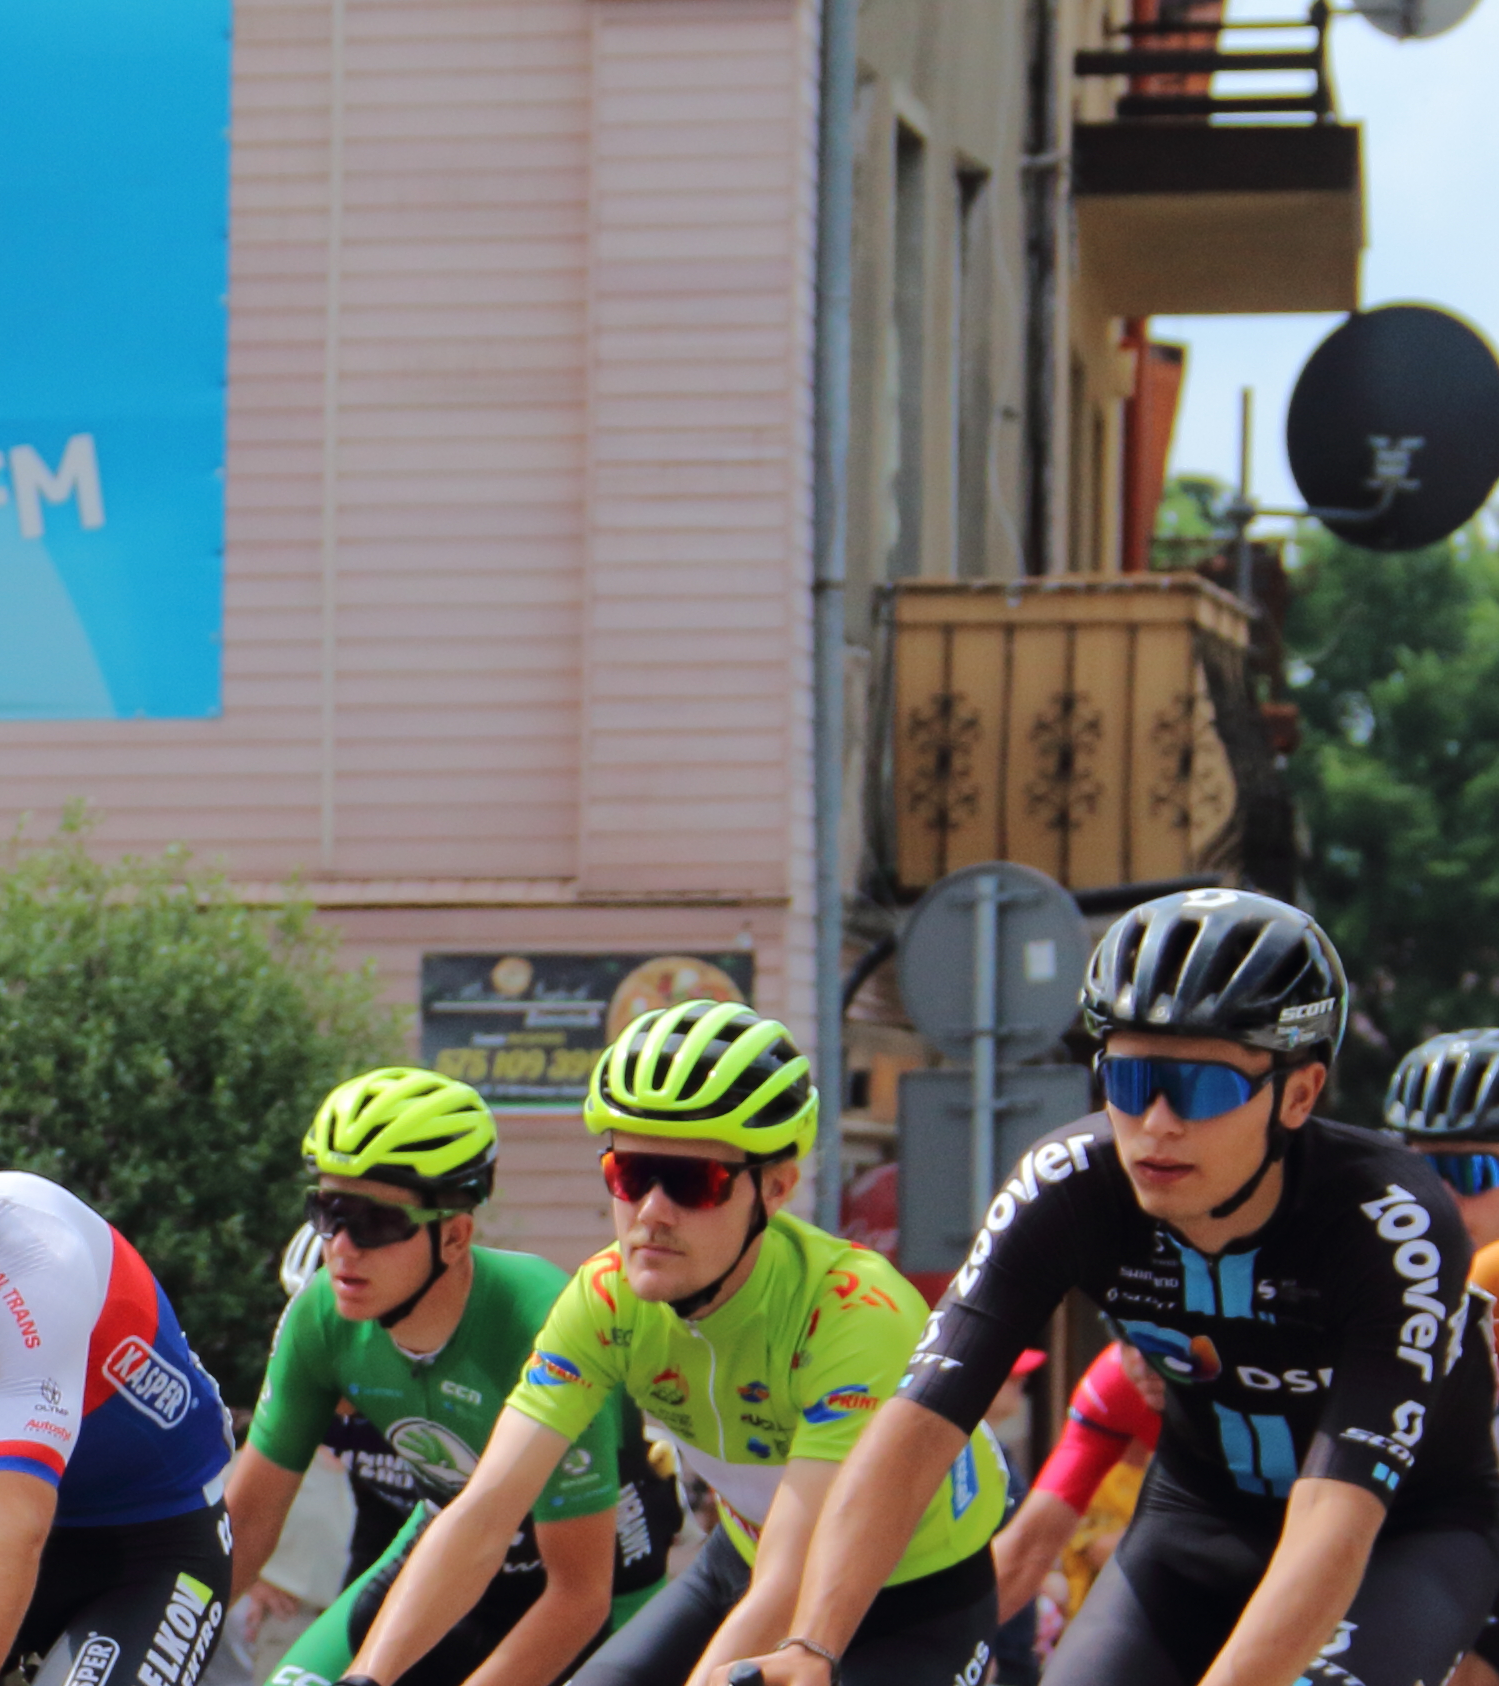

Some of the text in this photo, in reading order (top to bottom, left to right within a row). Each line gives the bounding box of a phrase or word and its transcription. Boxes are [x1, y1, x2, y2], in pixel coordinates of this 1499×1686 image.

[1278, 997, 1336, 1022] SCOTT
[949, 1133, 1096, 1299] zoover
[3, 1287, 42, 1350] TRANS
[1360, 1184, 1446, 1383] zoover
[113, 1344, 185, 1421] KASPER
